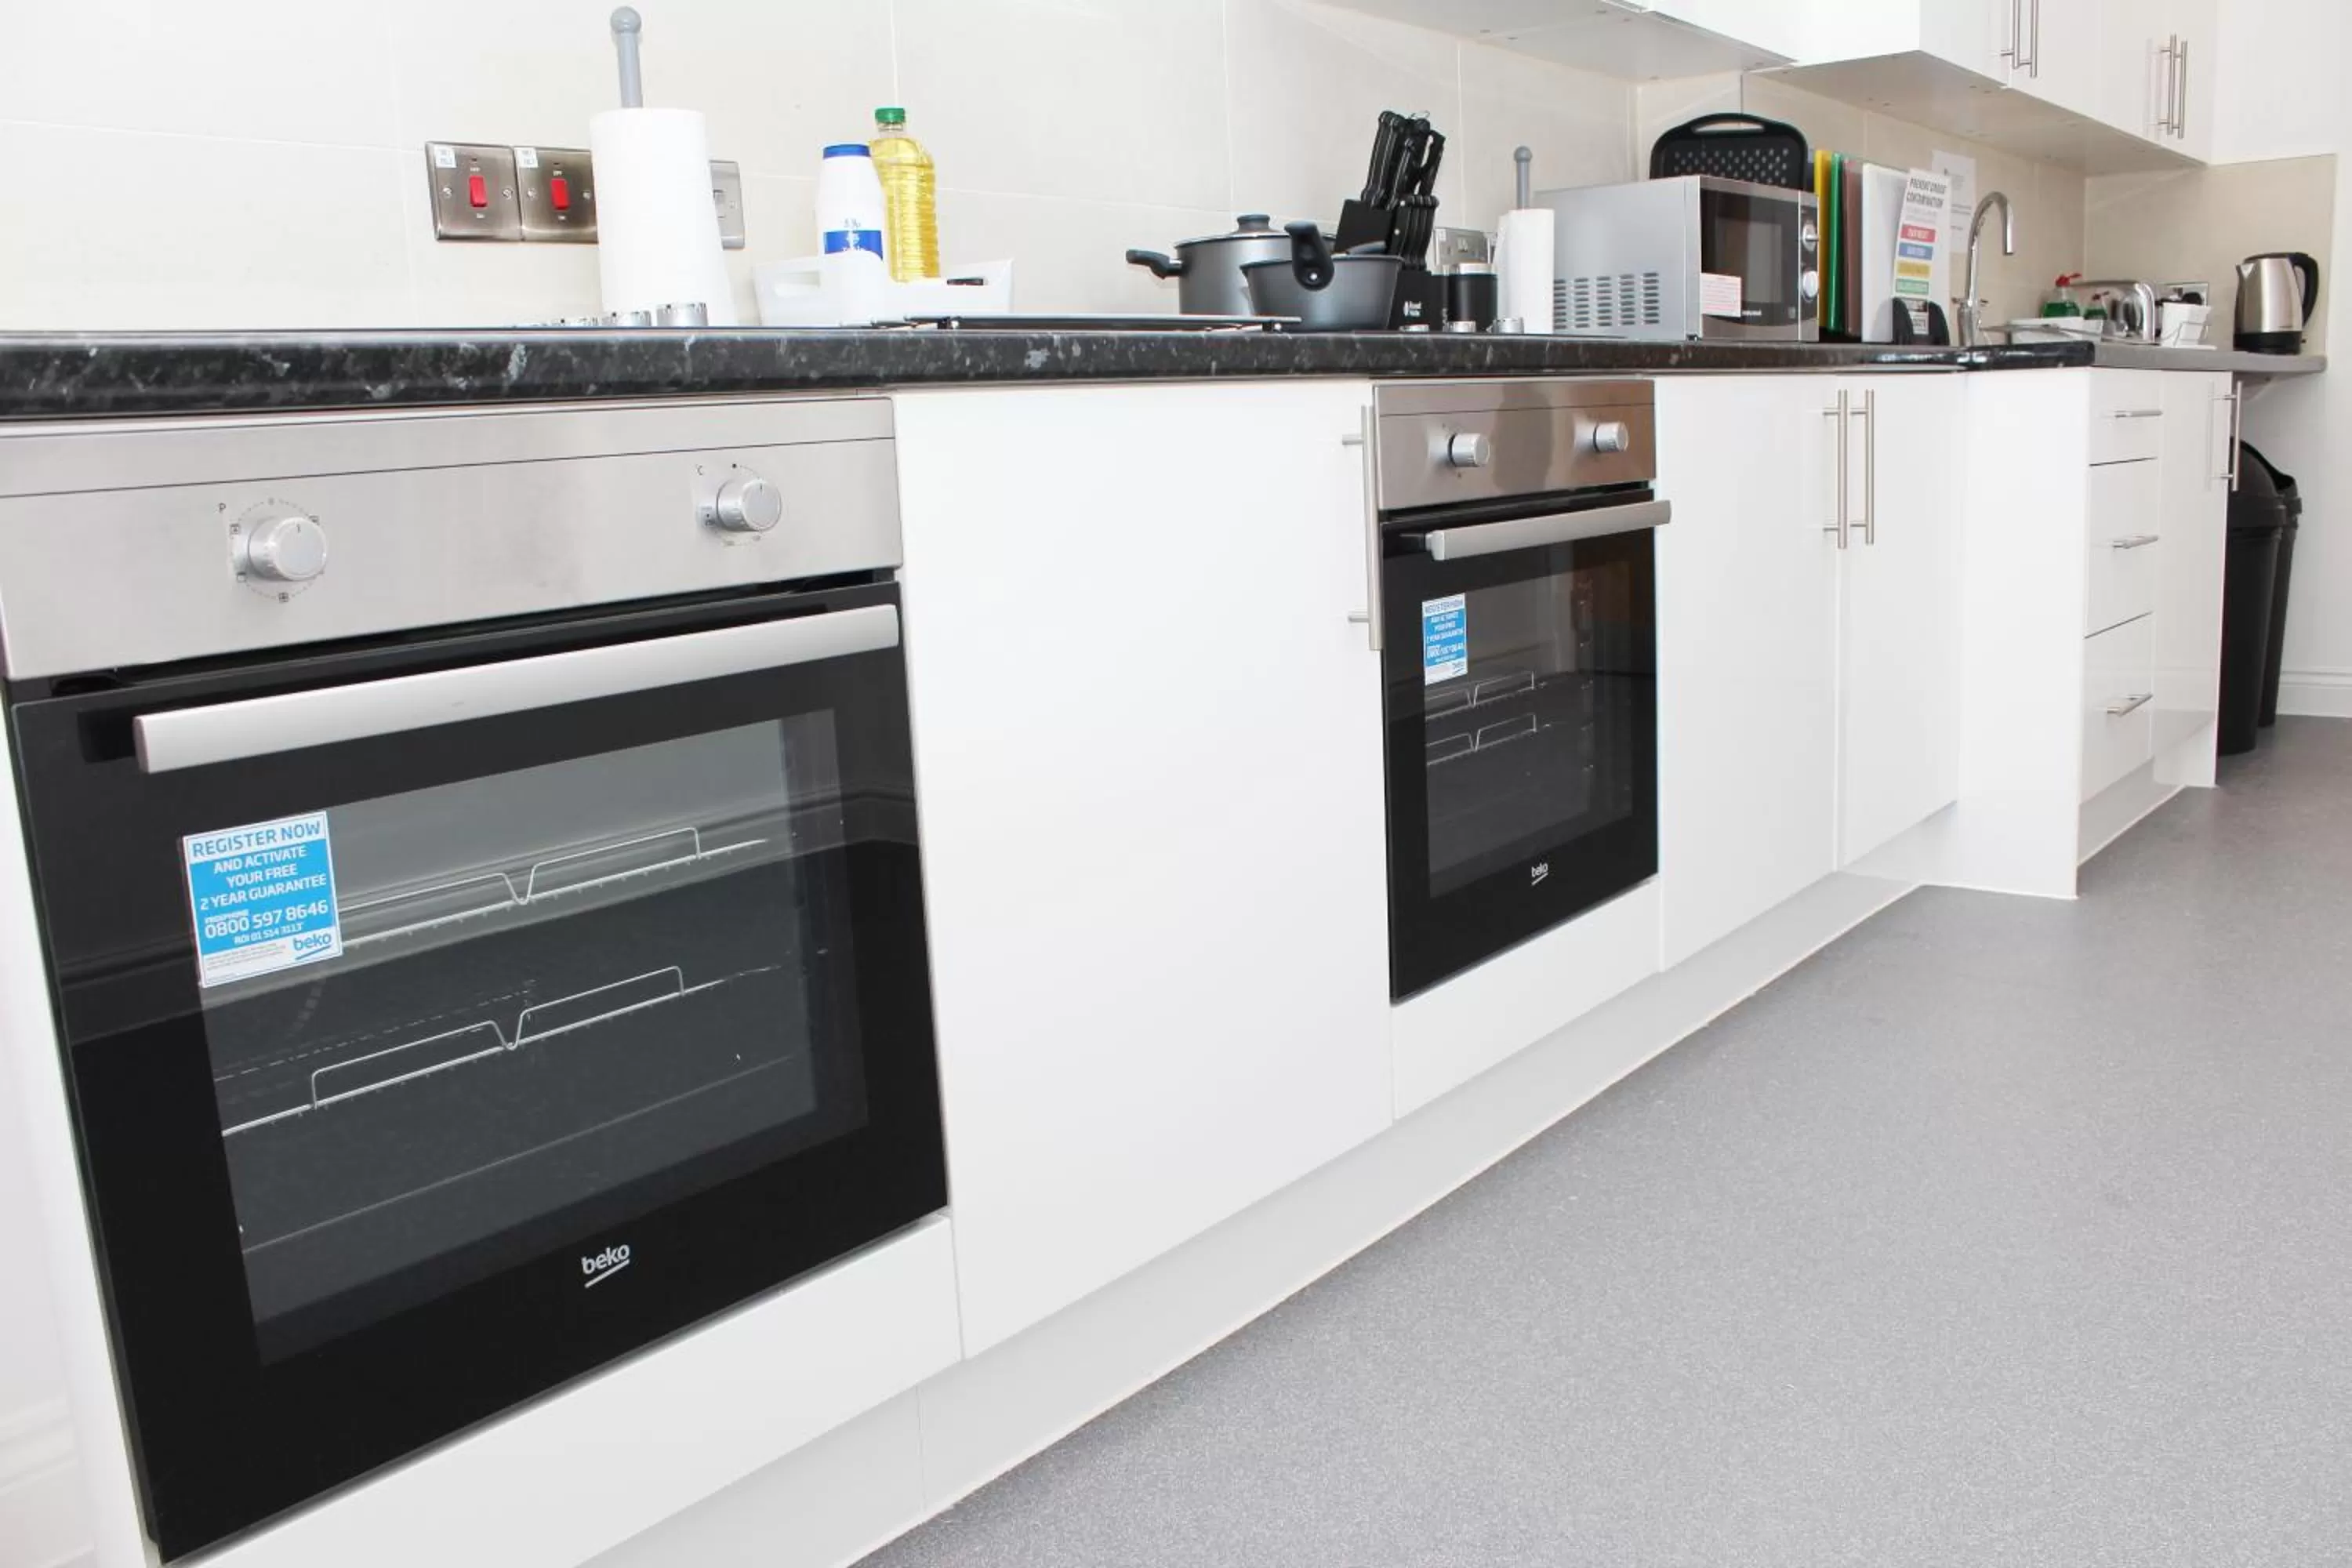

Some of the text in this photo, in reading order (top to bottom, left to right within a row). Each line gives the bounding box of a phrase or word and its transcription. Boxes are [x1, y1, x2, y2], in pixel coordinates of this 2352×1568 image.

[193, 821, 321, 858] REGISTER NOW
[213, 845, 307, 874] AND ACTIVATE
[226, 863, 299, 888] YOUR FREE
[200, 873, 327, 910] 2 YEAR GUARANTEE
[205, 916, 250, 939] 0800
[252, 909, 283, 930] 597
[285, 899, 329, 922] 8646
[293, 932, 332, 951] beko
[581, 1244, 630, 1275] beko
